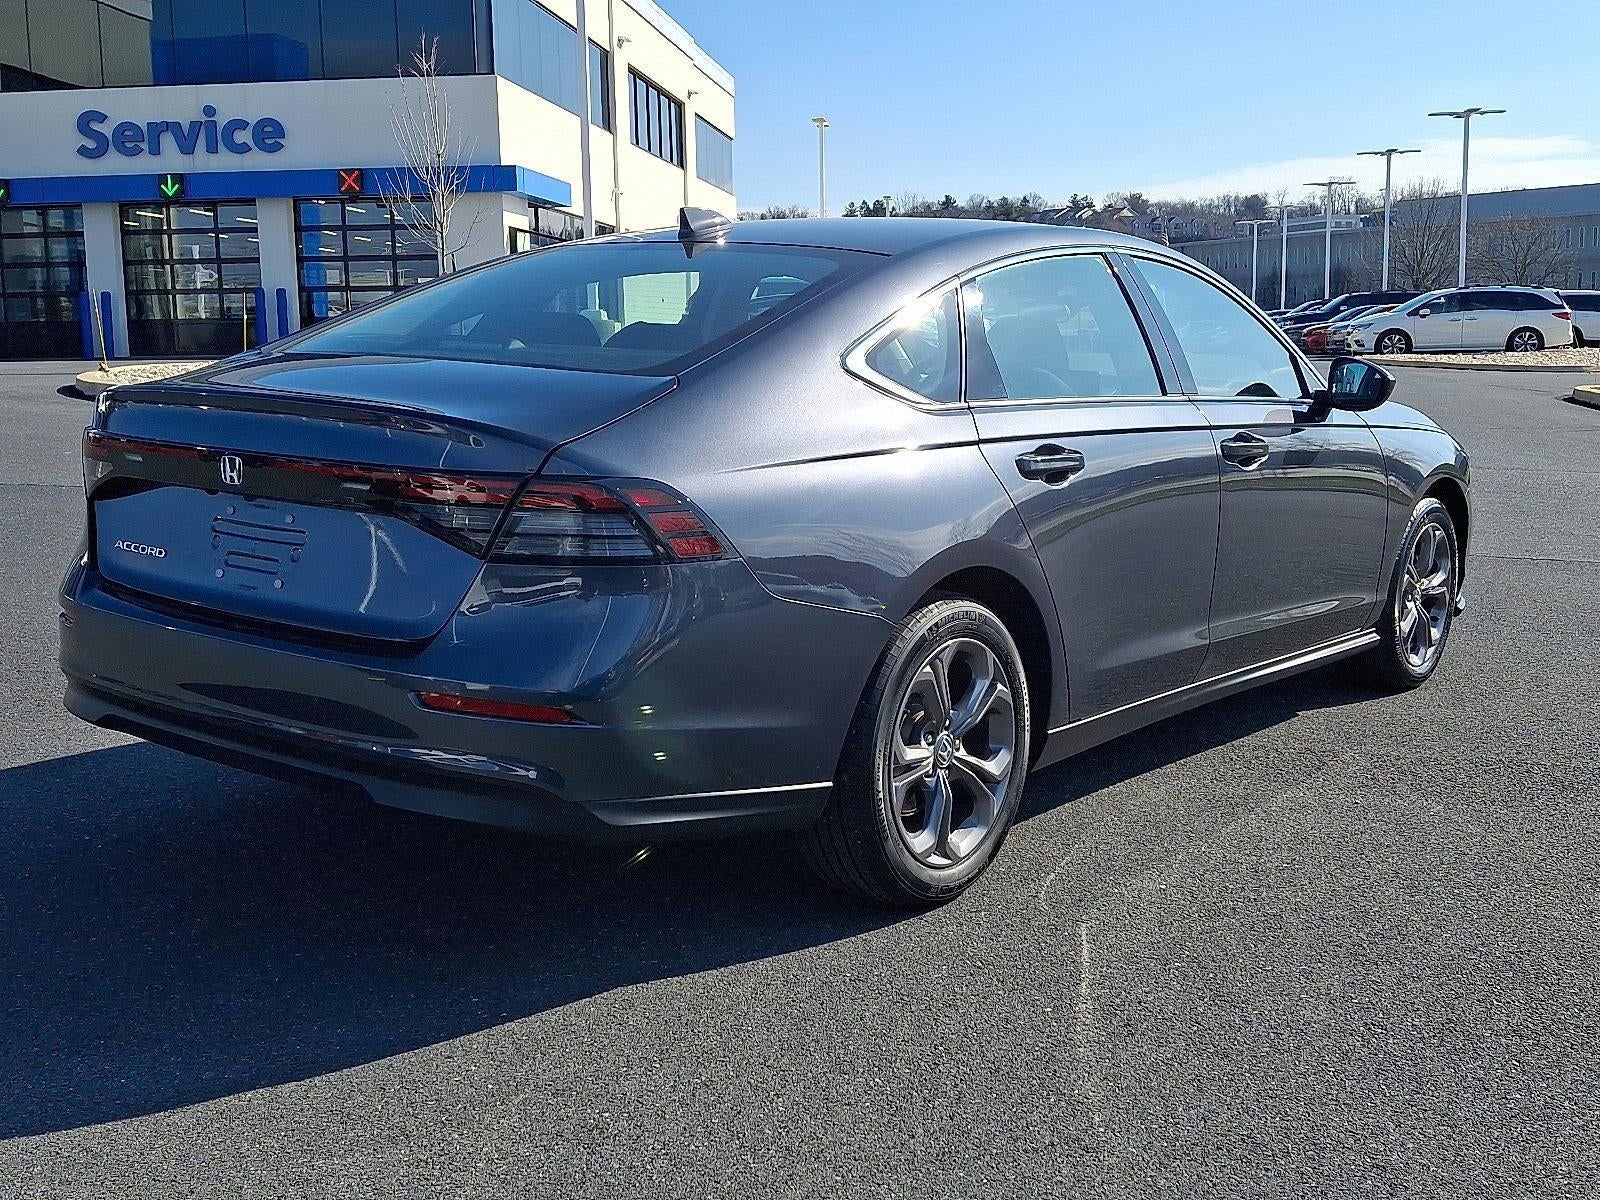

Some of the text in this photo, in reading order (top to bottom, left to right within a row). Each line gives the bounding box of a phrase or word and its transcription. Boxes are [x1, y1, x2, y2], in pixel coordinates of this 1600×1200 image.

[76, 104, 285, 159] Service
[114, 540, 166, 558] ACCORD
[938, 611, 976, 628] MICHELIN
